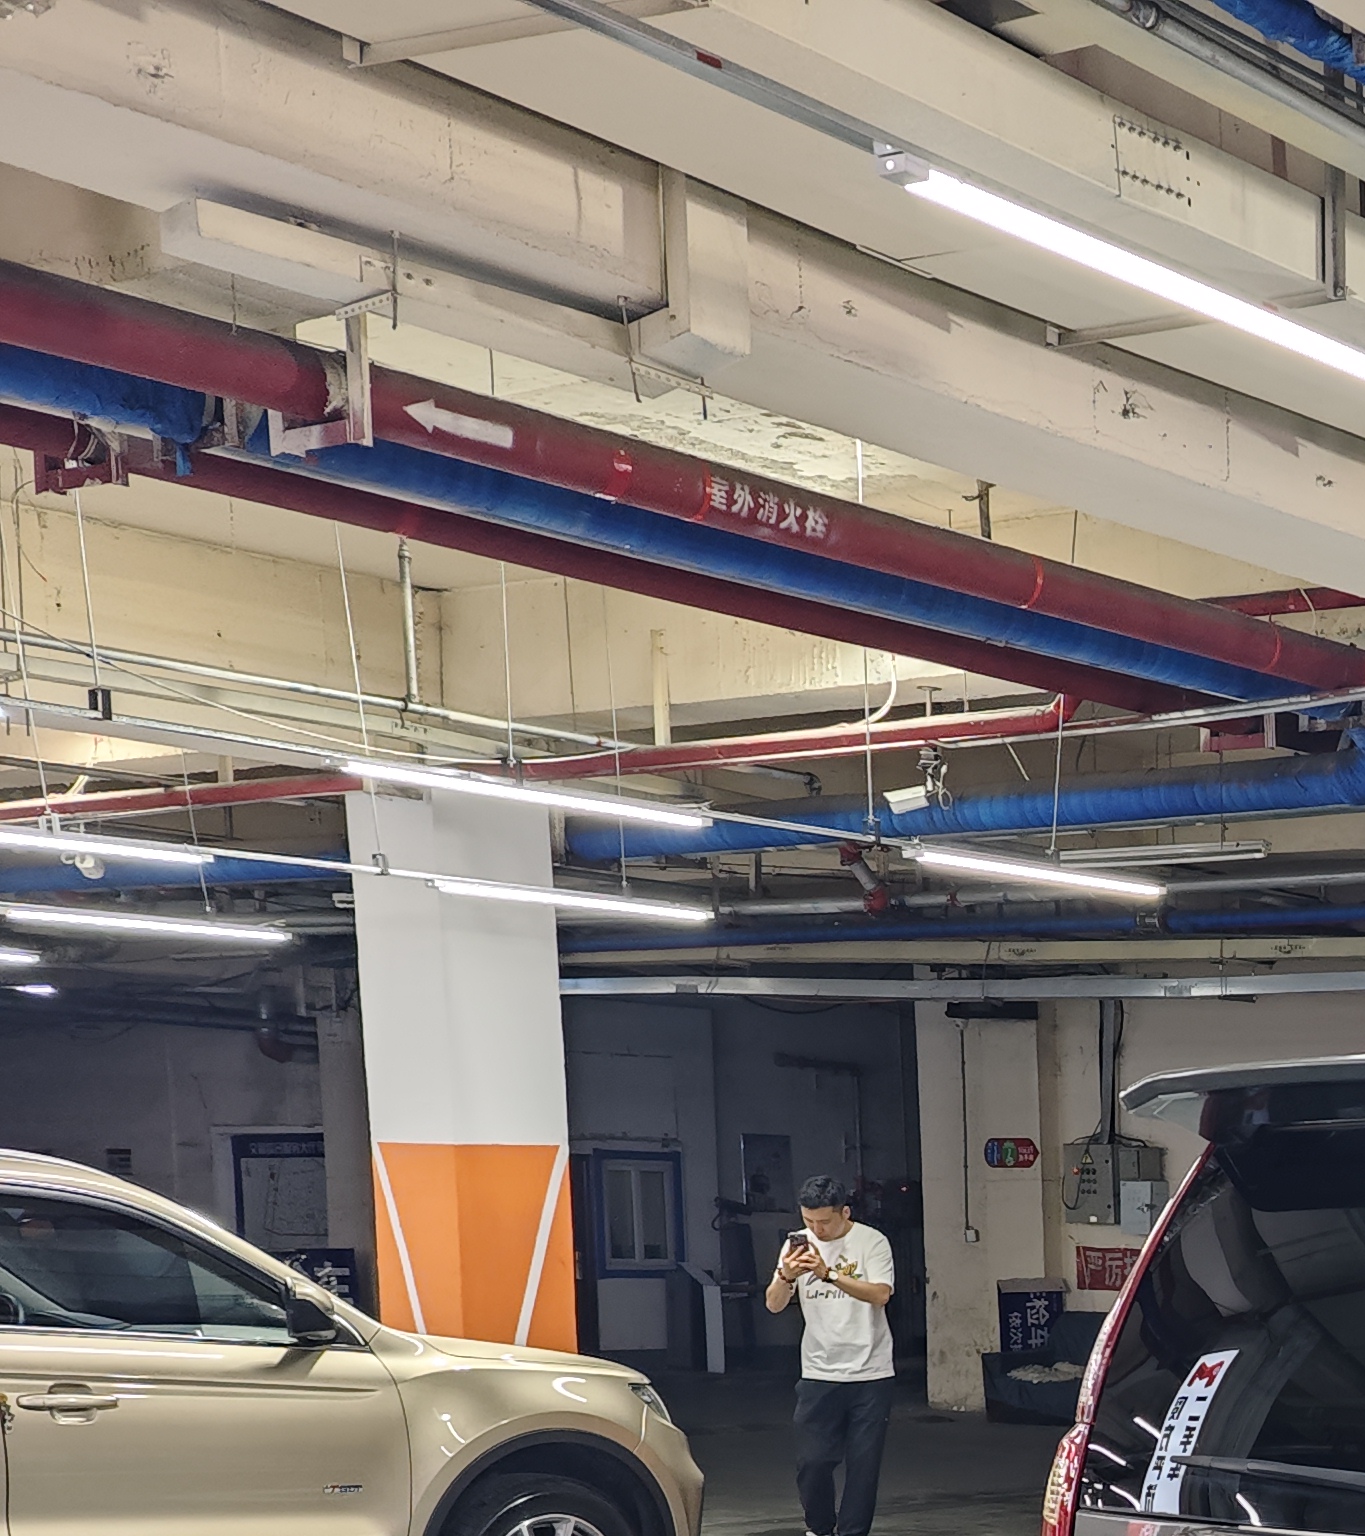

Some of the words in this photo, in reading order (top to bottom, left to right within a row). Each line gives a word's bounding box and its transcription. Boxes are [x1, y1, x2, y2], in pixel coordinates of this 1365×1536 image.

[709, 475, 829, 540] 室外消火栓
